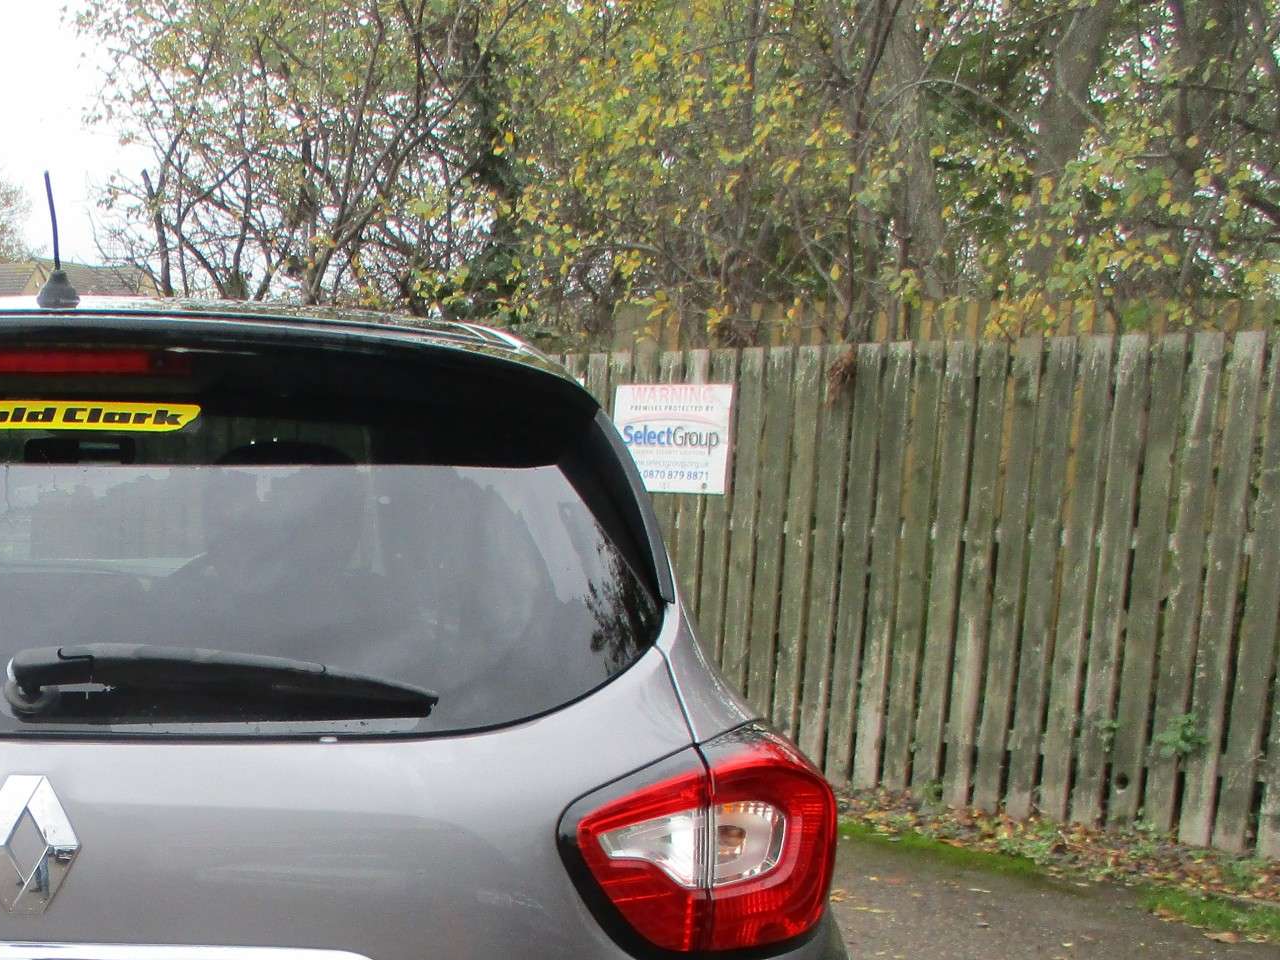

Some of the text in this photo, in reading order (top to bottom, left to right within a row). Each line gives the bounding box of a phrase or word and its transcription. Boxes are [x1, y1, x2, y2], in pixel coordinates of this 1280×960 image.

[632, 387, 719, 402] WARNING
[62, 407, 183, 426] Clark
[623, 424, 720, 456] SelectGroup
[643, 470, 709, 481] 0870 879 8871
